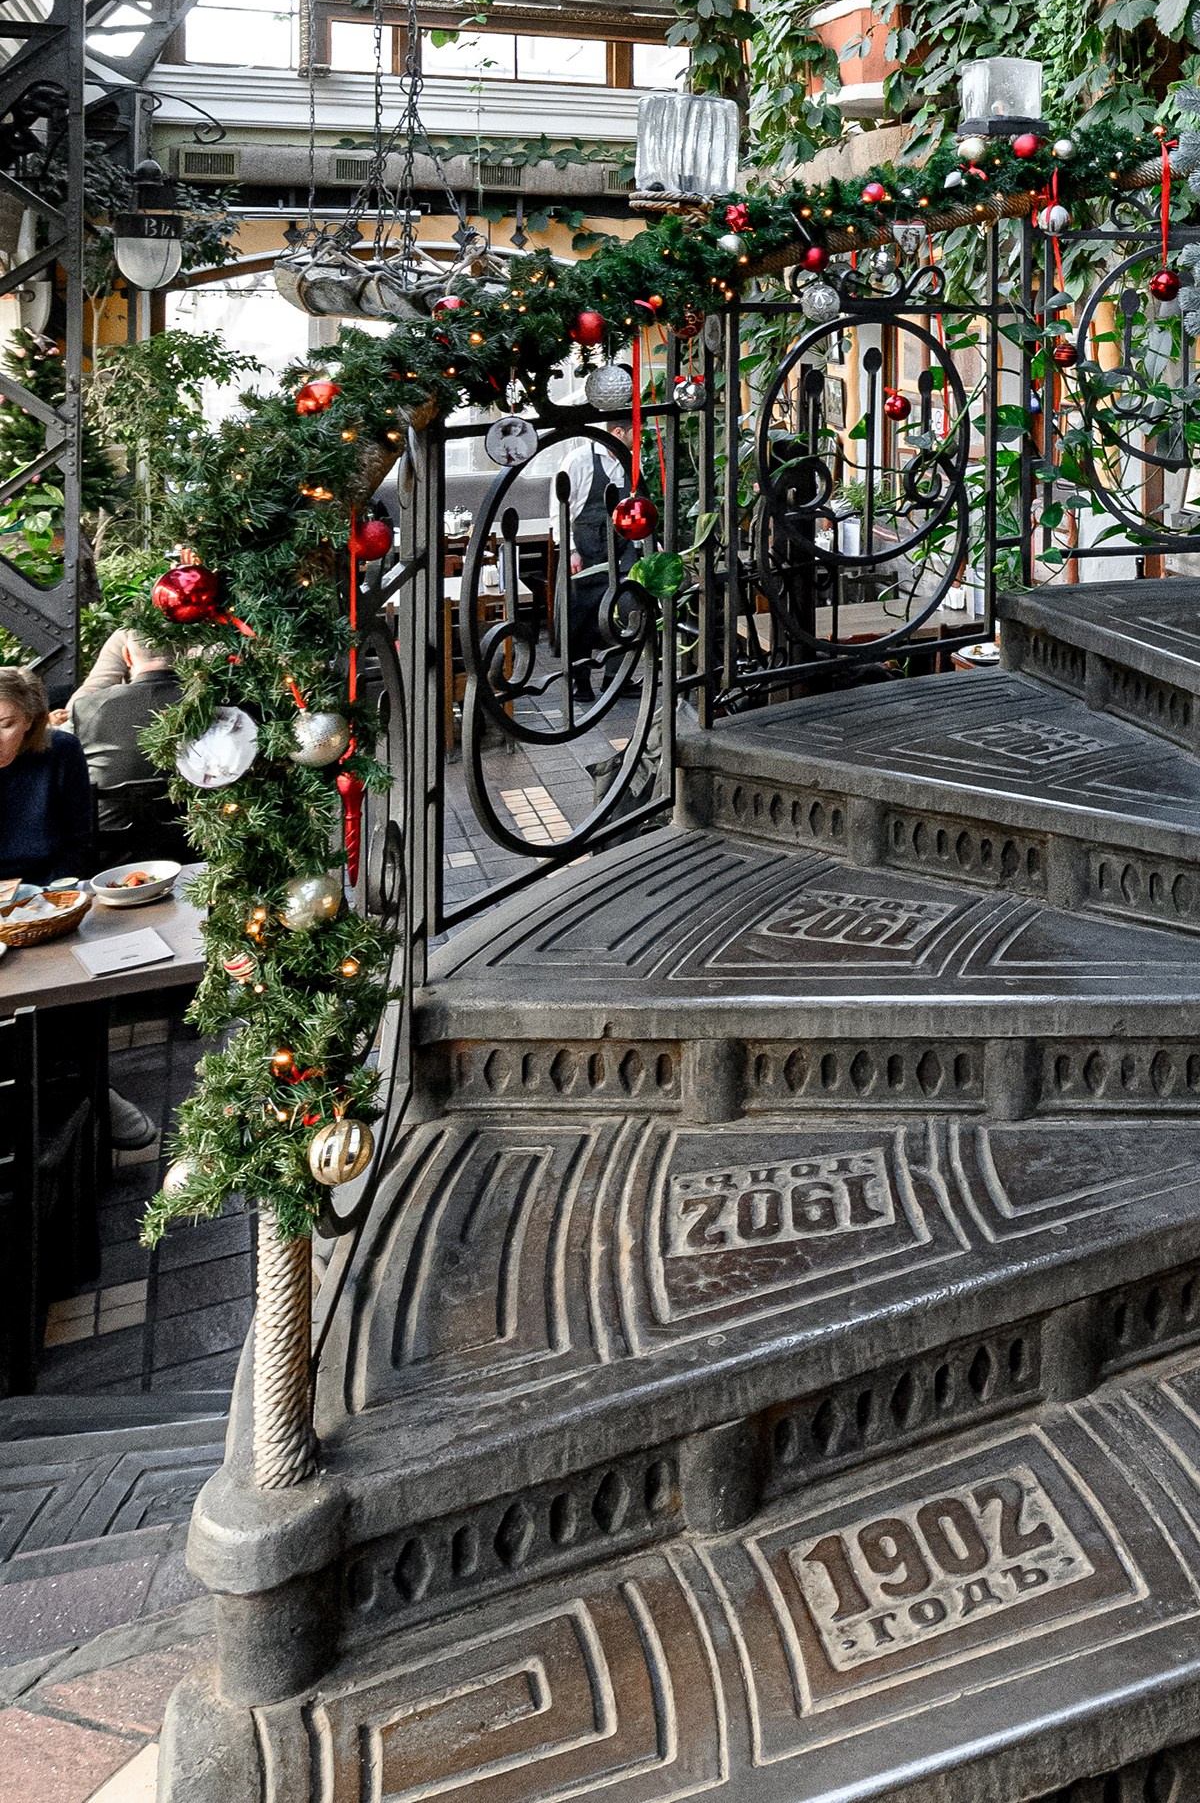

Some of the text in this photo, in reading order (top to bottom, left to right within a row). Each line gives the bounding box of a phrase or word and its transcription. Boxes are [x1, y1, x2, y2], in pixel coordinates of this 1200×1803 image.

[766, 899, 934, 947] 1902
[680, 1173, 885, 1248] 1902
[802, 1477, 1055, 1622] 1902
